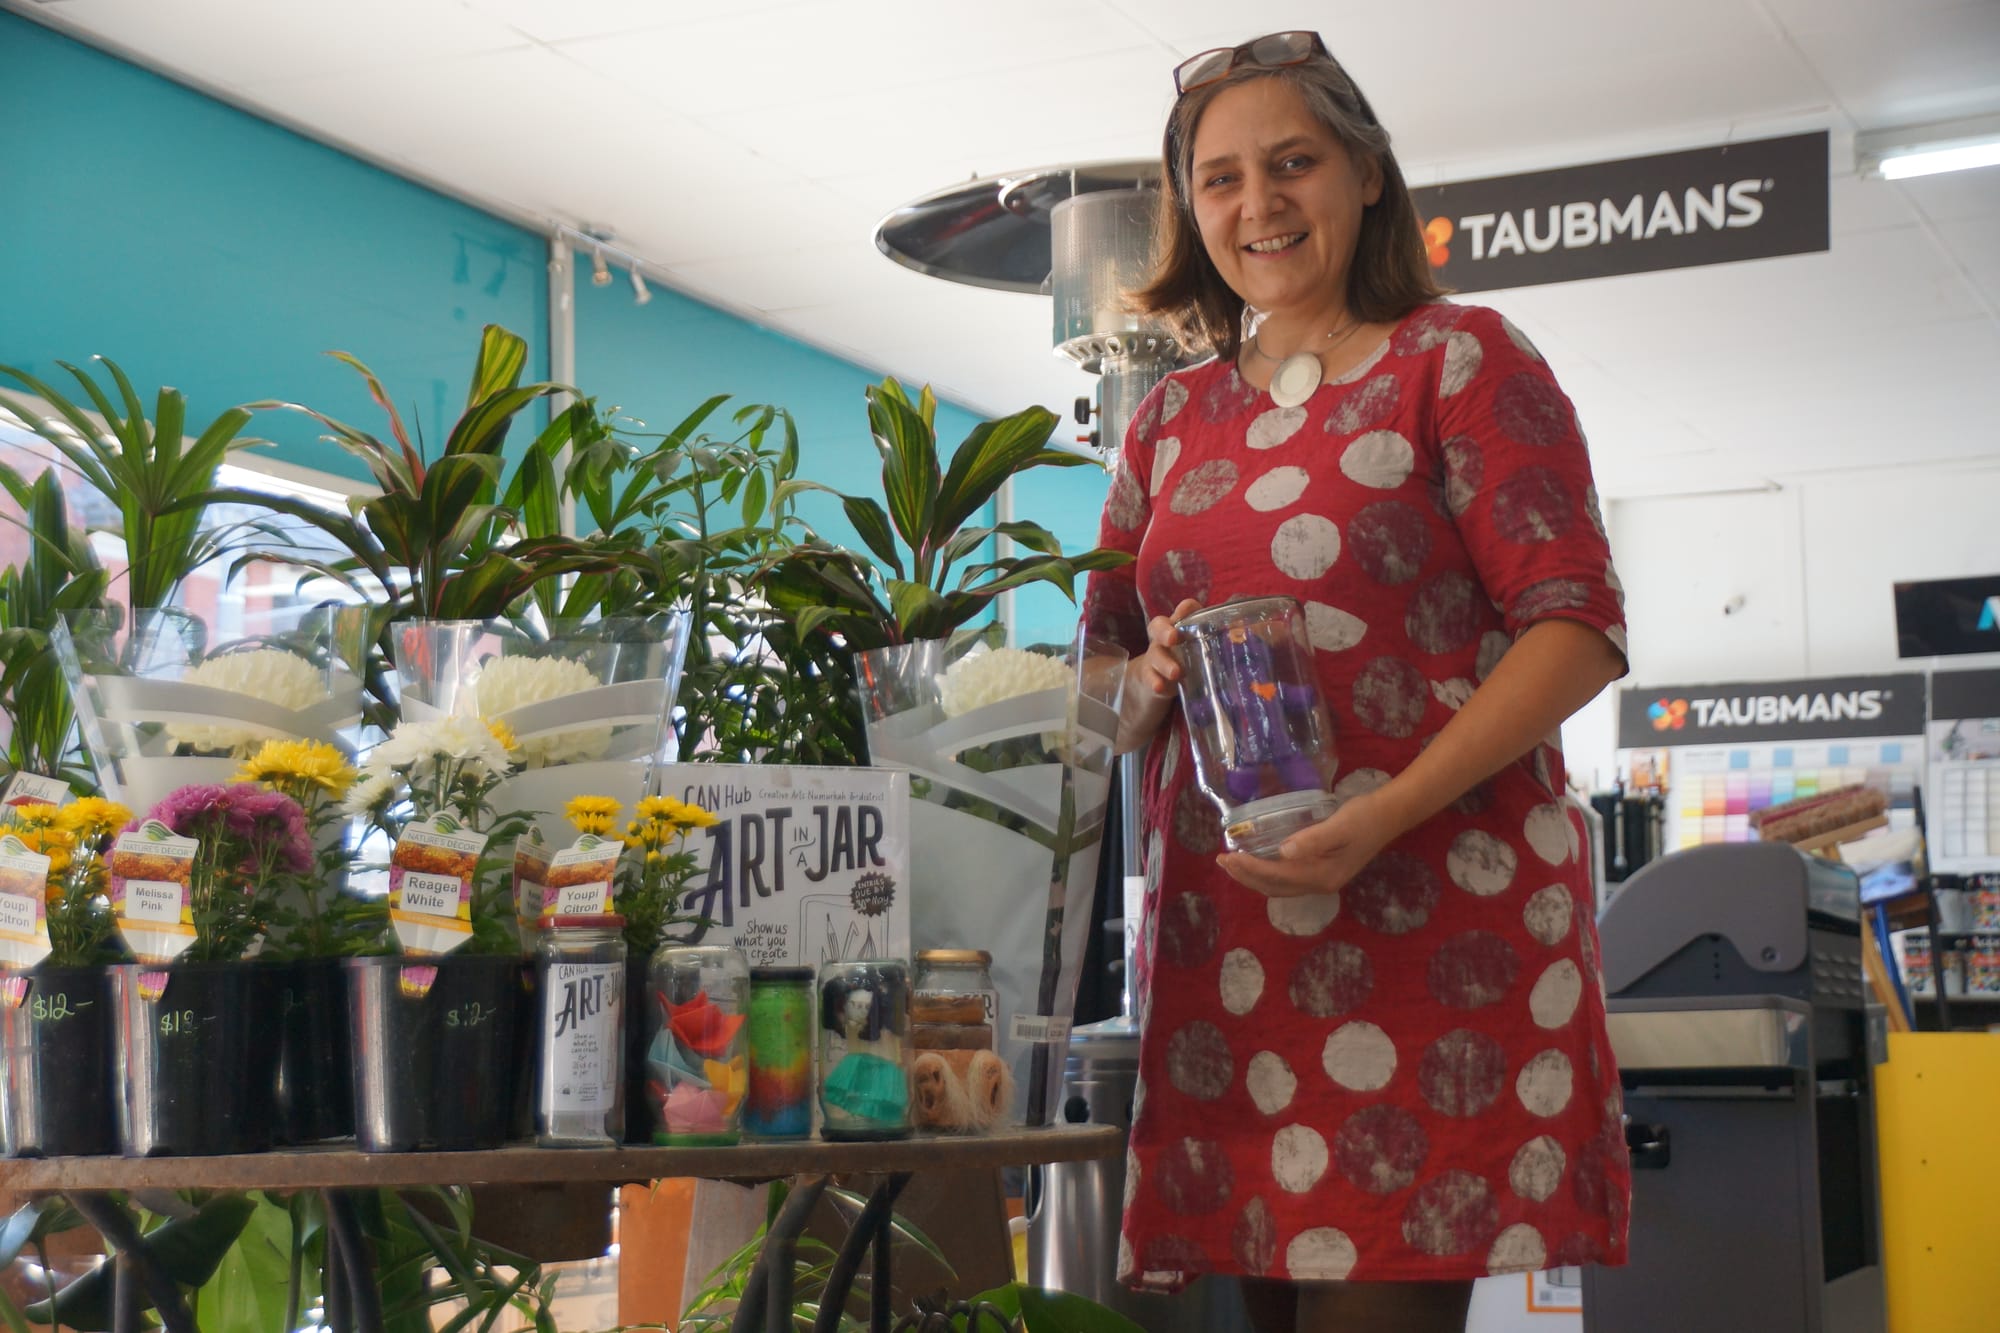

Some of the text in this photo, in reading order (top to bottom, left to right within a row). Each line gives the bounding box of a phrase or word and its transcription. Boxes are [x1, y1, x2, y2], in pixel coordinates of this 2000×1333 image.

[1460, 178, 1765, 261] TAUBMANS
[1690, 689, 1883, 728] TAUBMANS
[725, 784, 752, 808] Hub
[759, 788, 789, 800] Creative
[791, 789, 805, 800] Arts
[684, 805, 886, 942] ART IN A JAR
[409, 876, 458, 894] Reagea
[855, 884, 885, 898] DUE BY
[858, 878, 885, 889] ENTRIES
[136, 887, 174, 900] Melissa
[407, 892, 445, 908] White
[567, 888, 600, 902] Youpi
[0, 898, 29, 913] oupi
[141, 900, 163, 911] Pink
[564, 904, 598, 914] Citron
[746, 918, 788, 935] Show us
[734, 933, 786, 950] what you
[750, 947, 788, 959] create
[555, 974, 605, 1038] ART
